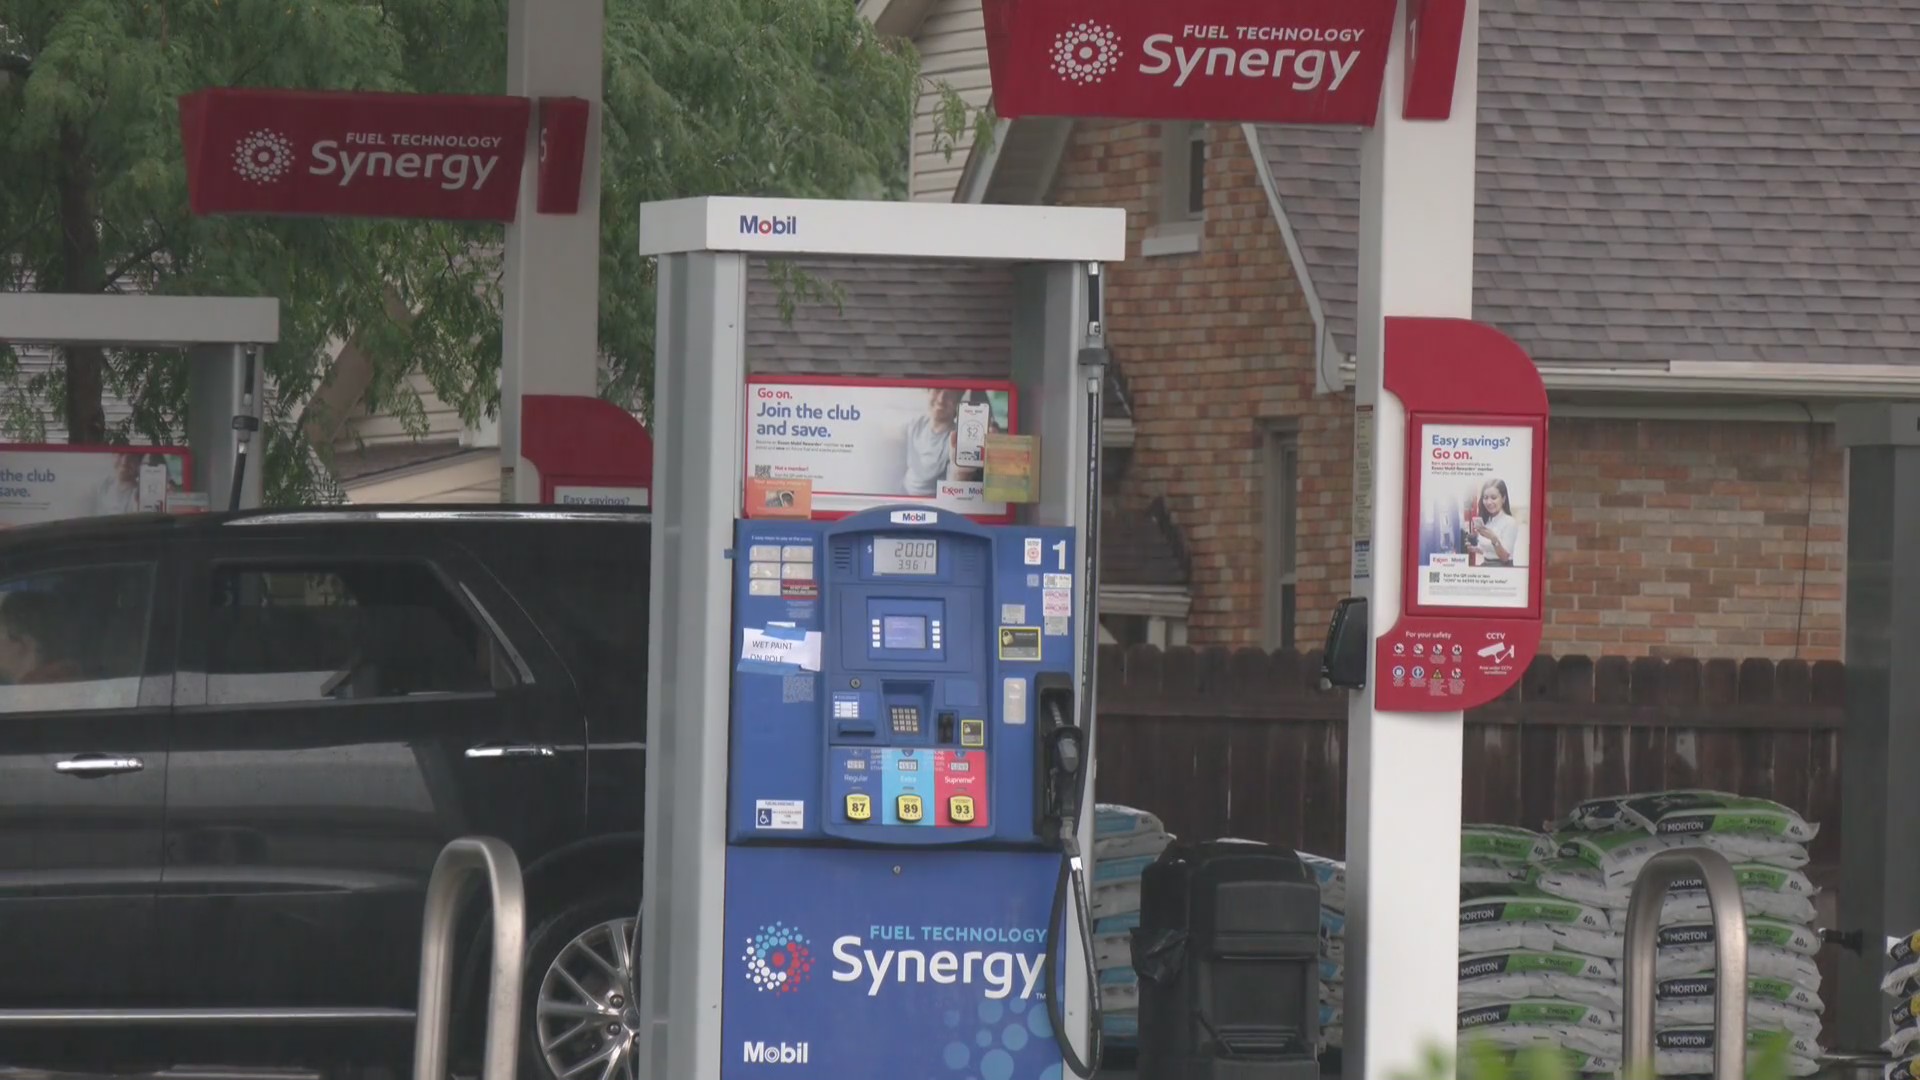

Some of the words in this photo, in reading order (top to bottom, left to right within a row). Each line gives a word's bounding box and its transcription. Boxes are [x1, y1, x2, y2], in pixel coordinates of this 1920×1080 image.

[1183, 25, 1229, 40] FUEL
[1236, 27, 1365, 42] TECHNOLOGY
[1409, 18, 1417, 60] 1
[1139, 34, 1361, 91] Synergy
[346, 132, 386, 145] FUEL
[392, 134, 502, 149] TECHNOLOGY
[308, 140, 499, 190] Synergy
[740, 215, 796, 234] Mobil
[757, 387, 773, 399] Go
[776, 391, 793, 399] on.
[757, 402, 791, 418] Join
[796, 403, 823, 419] the
[827, 404, 861, 420] club
[757, 420, 786, 436] and
[791, 425, 831, 438] save.
[1432, 434, 1459, 449] Easy
[1462, 435, 1511, 450] savings?
[1432, 447, 1450, 459] Go
[1454, 450, 1473, 460] on.
[0, 468, 23, 482] the
[27, 468, 55, 482] club
[942, 486, 964, 497] Exxon
[969, 487, 984, 496] Mob
[563, 495, 586, 505] Easy
[588, 496, 630, 505] savings?
[902, 513, 926, 522] Mobil
[867, 544, 873, 554] $
[1052, 540, 1066, 570] 1
[1432, 631, 1452, 640] safety
[1486, 632, 1506, 640] CCTV
[752, 640, 769, 649] WET
[770, 641, 792, 650] PAINT
[750, 653, 762, 662] ON
[844, 774, 868, 784] Regular
[852, 803, 866, 813] 87
[904, 804, 918, 814] 89
[955, 805, 970, 815] 93
[1667, 821, 1704, 832] MORTON
[870, 925, 914, 941] FUEL
[922, 926, 1047, 943] TECHNOLOGY
[1670, 932, 1707, 942] MORTON
[832, 935, 1047, 1000] Synergy
[1461, 962, 1498, 976] MORTON
[1670, 984, 1707, 994] MORTON
[1462, 1012, 1499, 1026] MORTON
[1668, 1036, 1705, 1046] MORTON
[744, 1041, 808, 1063] Mobil
